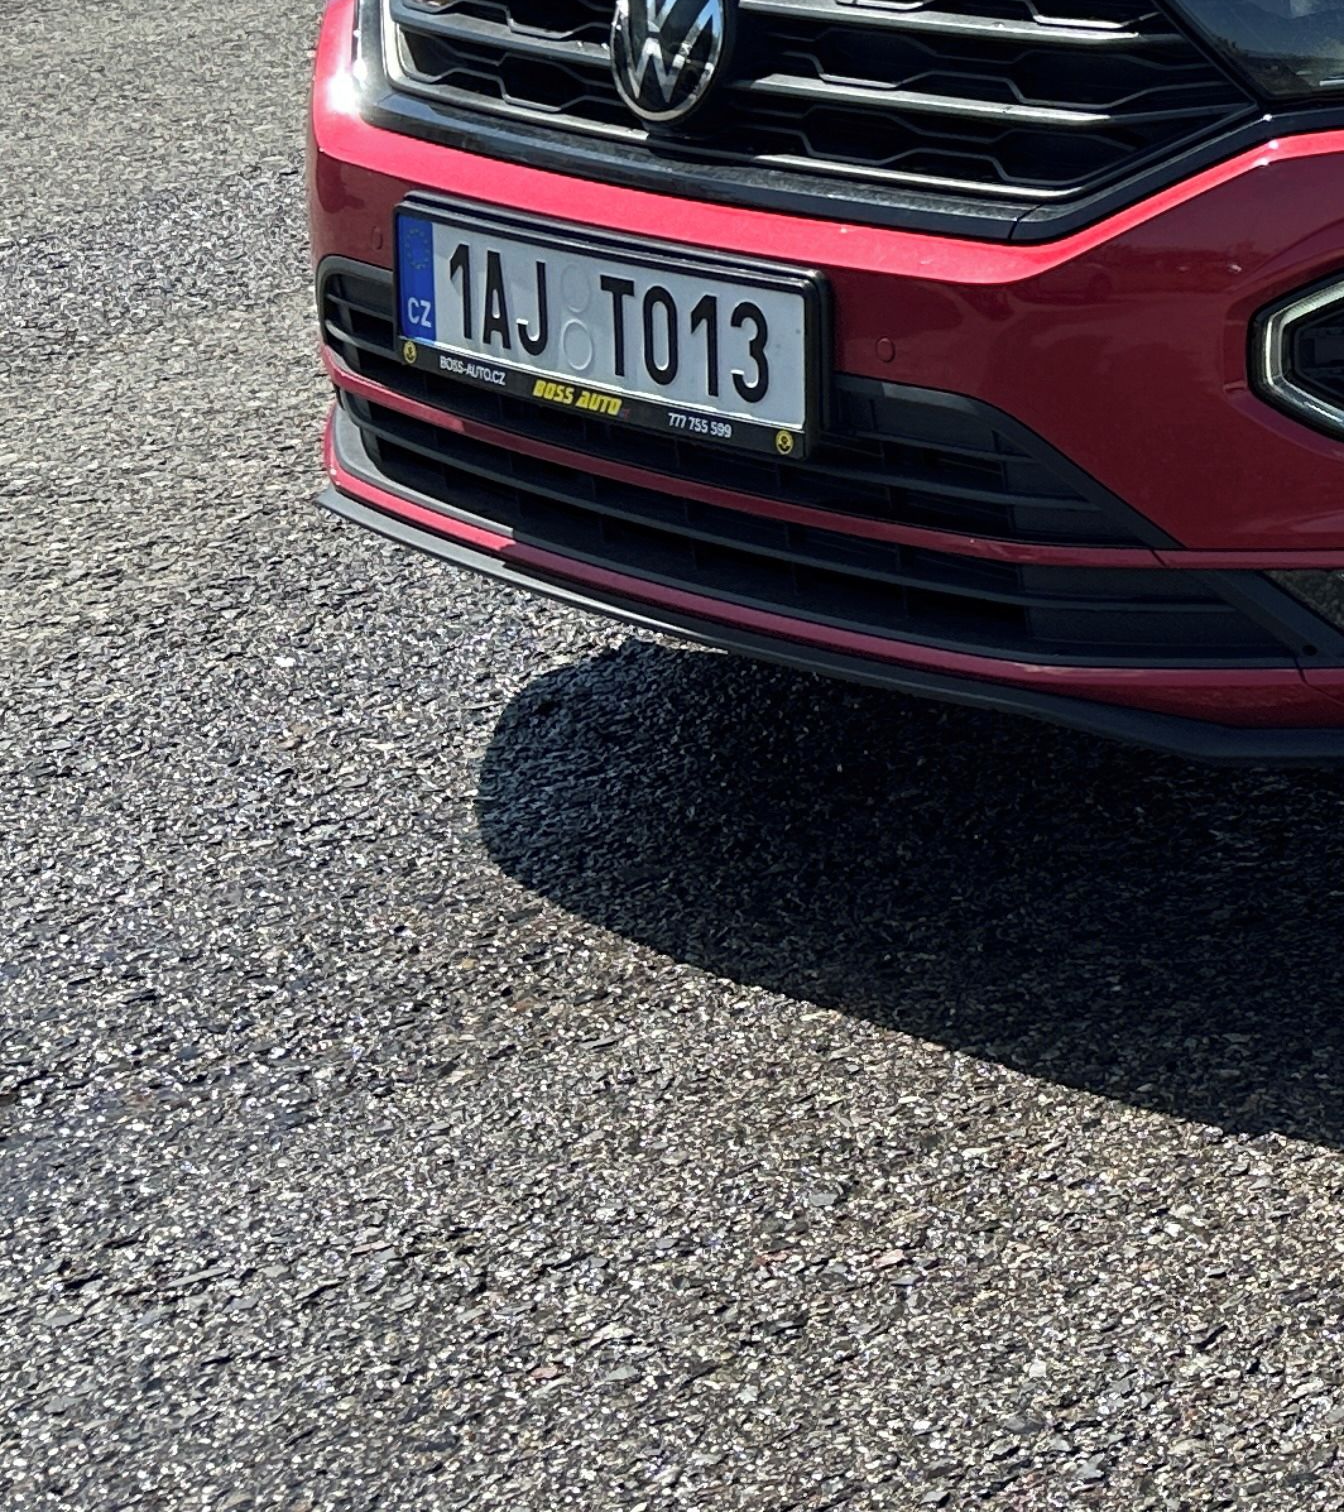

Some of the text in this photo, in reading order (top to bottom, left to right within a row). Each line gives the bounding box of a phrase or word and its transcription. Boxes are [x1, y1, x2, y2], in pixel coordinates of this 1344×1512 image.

[407, 297, 432, 327] CZ
[450, 243, 769, 403] 1AJ T013
[439, 355, 506, 386] BOSS-AUTO.CZ
[532, 379, 575, 405] BOSS
[576, 391, 623, 416] AUTO
